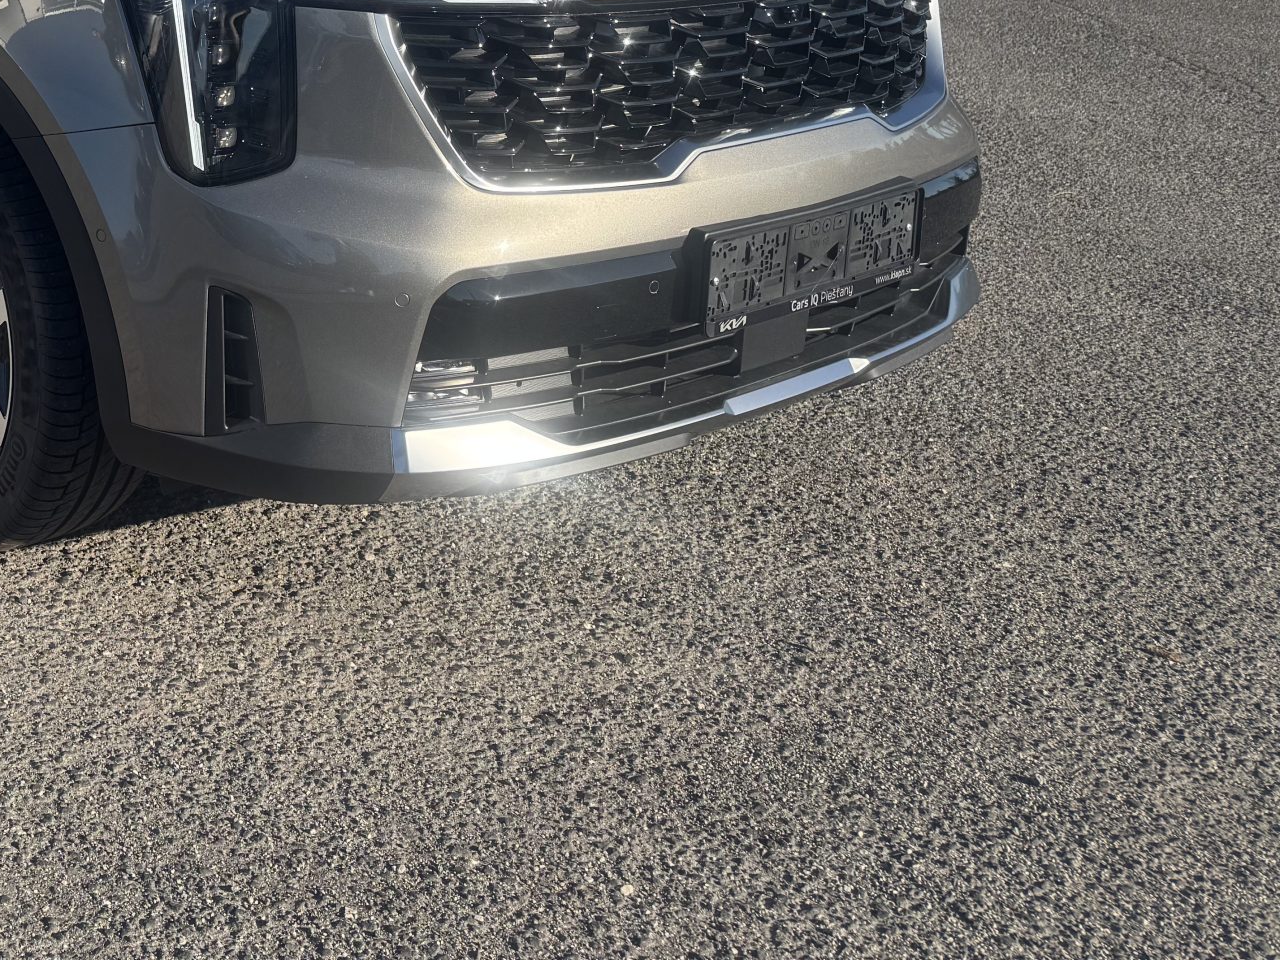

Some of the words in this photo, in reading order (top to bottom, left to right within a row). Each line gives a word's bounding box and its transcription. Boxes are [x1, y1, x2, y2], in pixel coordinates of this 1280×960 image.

[719, 315, 747, 333] KIA
[791, 299, 809, 312] Cars
[810, 293, 819, 306] IQ
